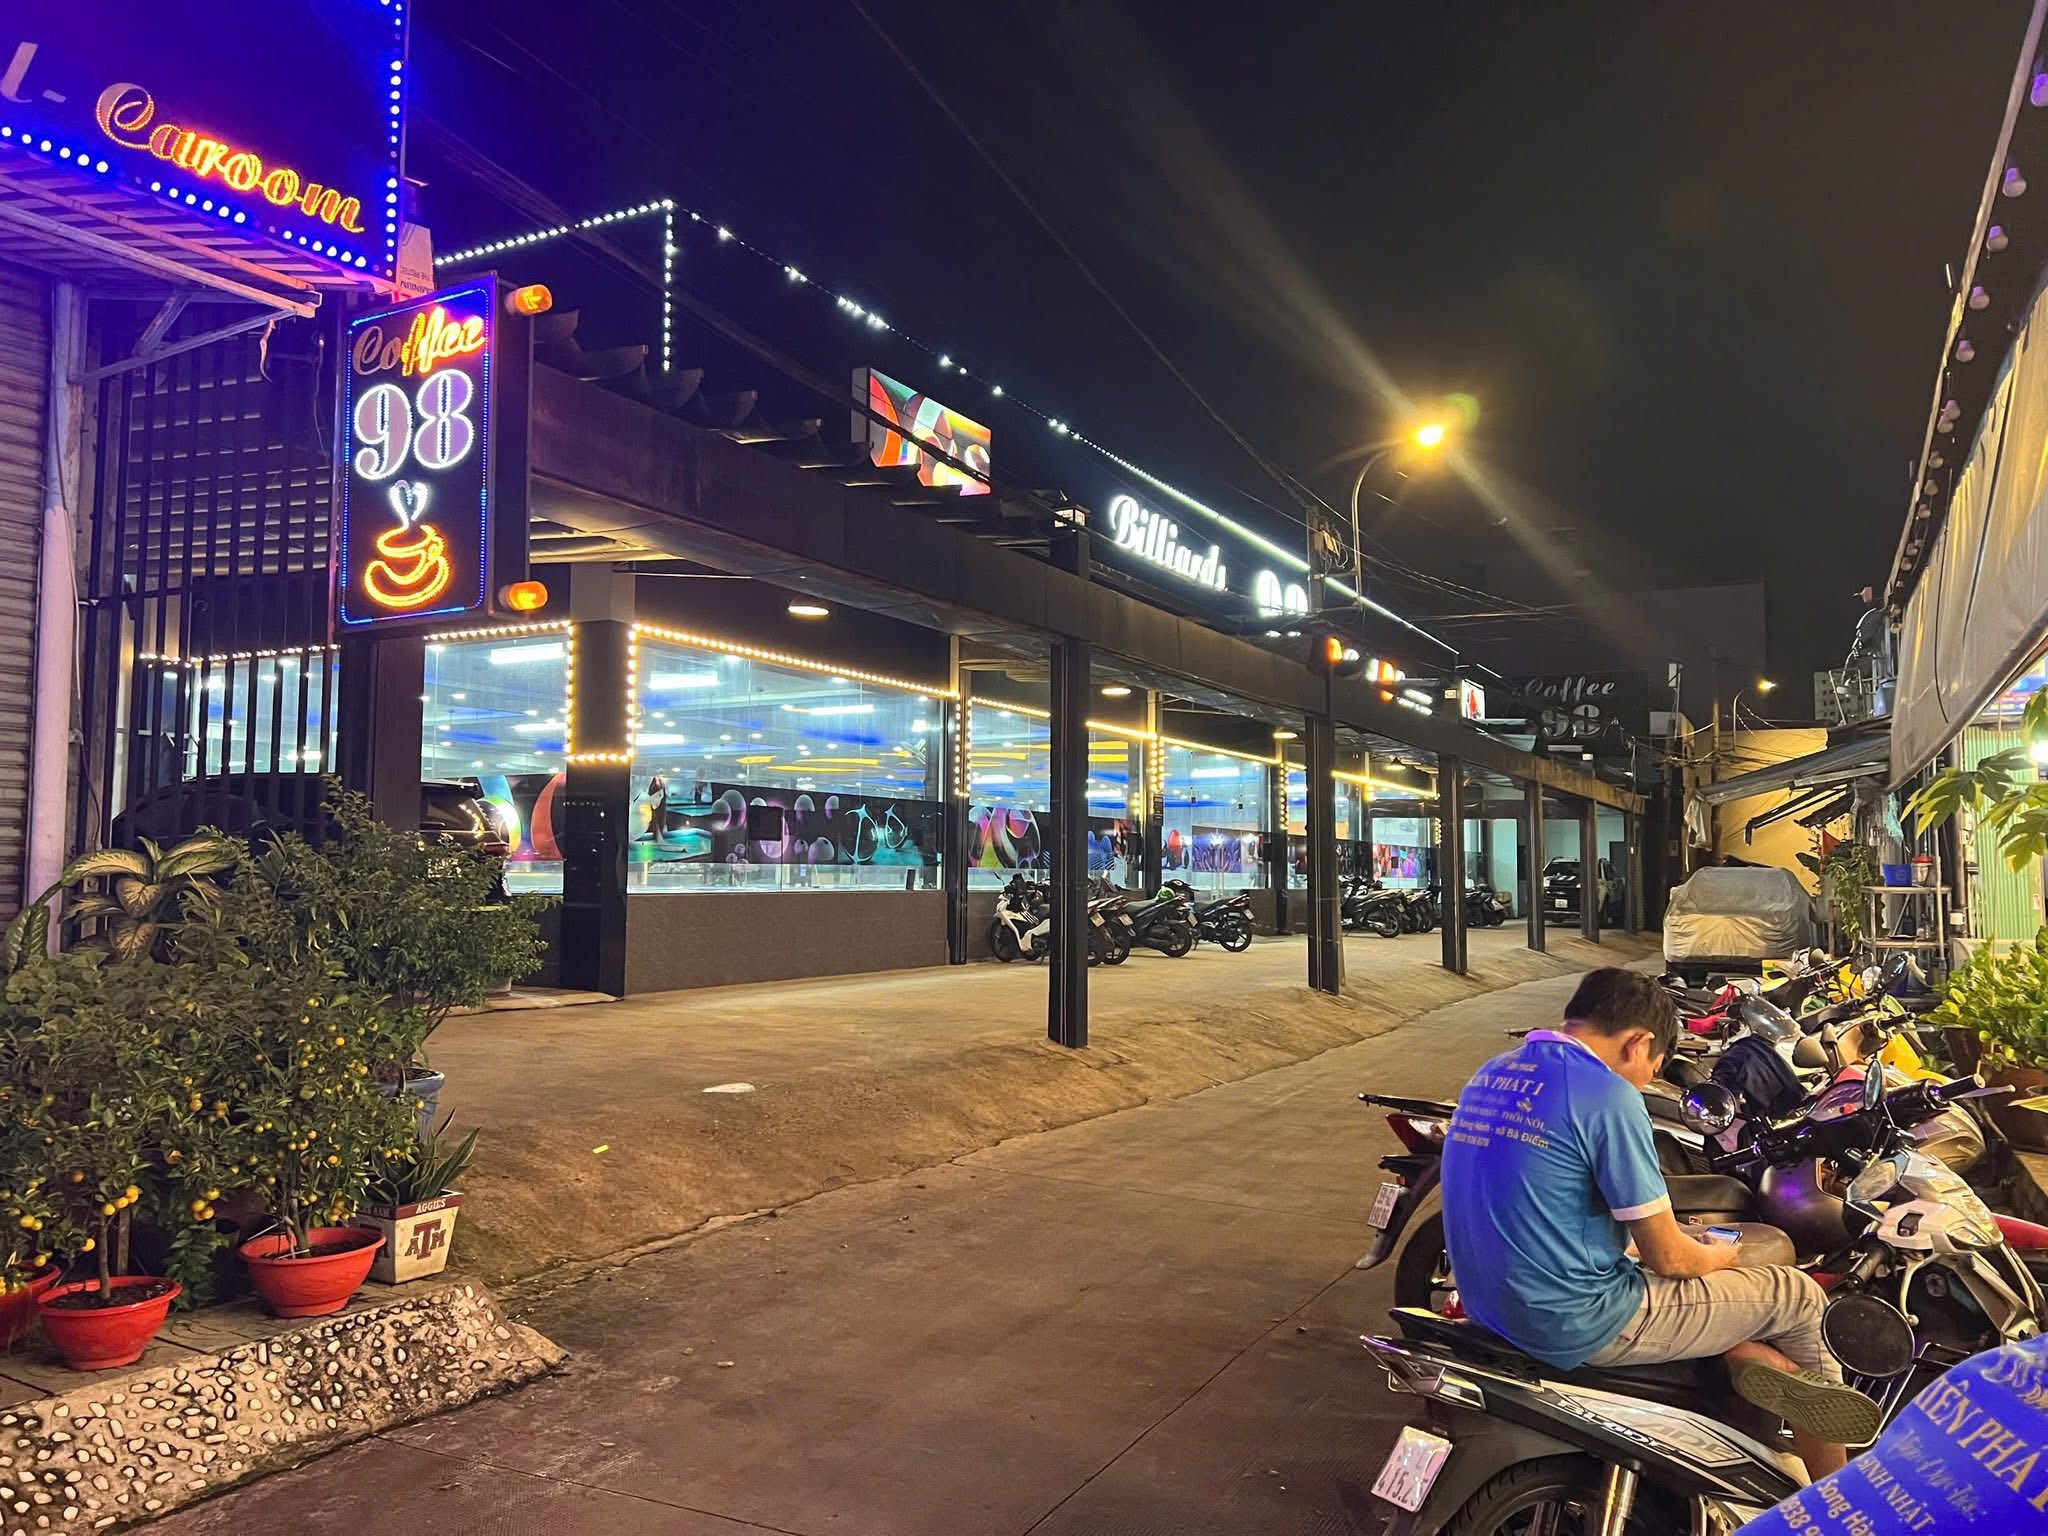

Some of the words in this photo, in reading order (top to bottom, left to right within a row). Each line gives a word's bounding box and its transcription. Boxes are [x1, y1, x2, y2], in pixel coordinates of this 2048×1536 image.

[96, 82, 365, 233] Caroom
[353, 305, 487, 378] Coffee
[353, 367, 475, 481] 98
[1109, 495, 1229, 592] Billiards
[1525, 675, 1615, 703] Coffee
[415, 1198, 446, 1215] AGGIES
[1557, 1398, 1674, 1456] BLADE
[1818, 1478, 1852, 1519] Song
[1841, 1510, 1877, 1536] Hà
[1880, 1482, 1936, 1531] NHẬT
